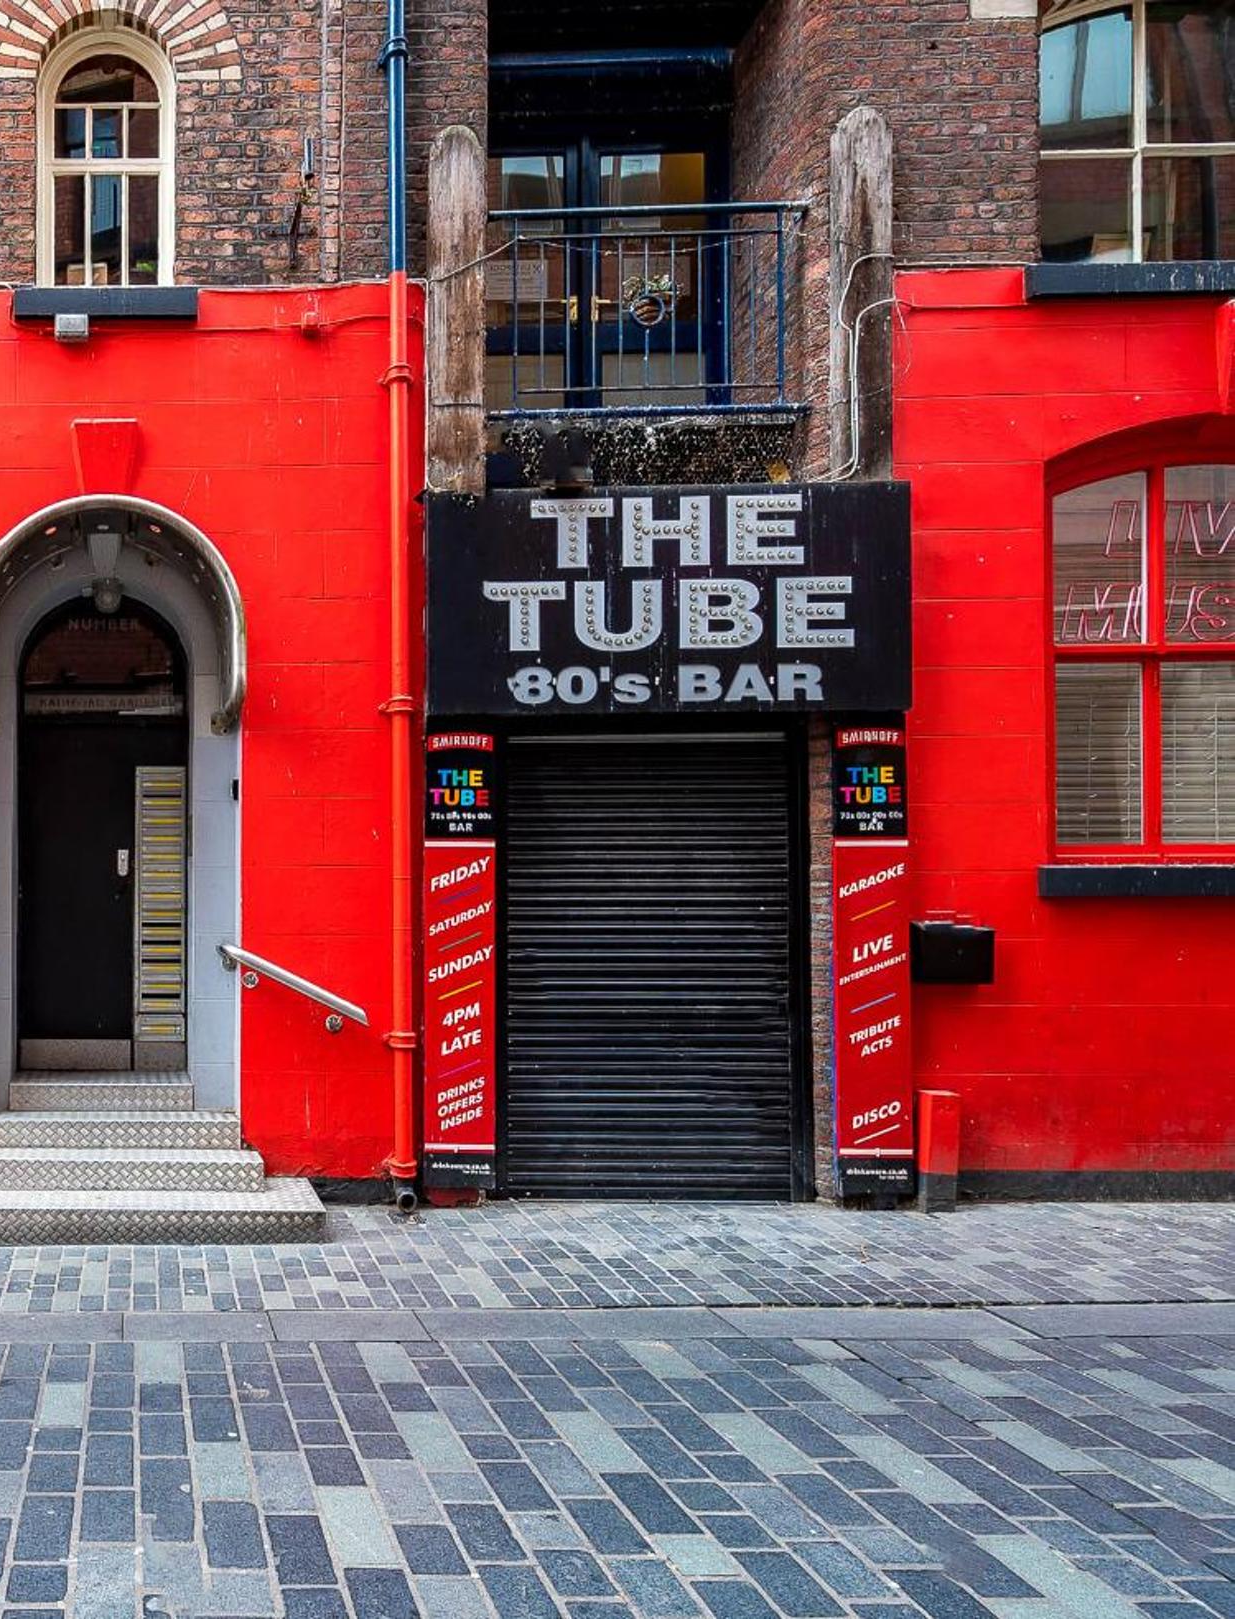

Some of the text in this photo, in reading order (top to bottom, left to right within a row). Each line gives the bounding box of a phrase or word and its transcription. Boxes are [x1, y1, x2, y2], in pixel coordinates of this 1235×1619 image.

[531, 493, 805, 569] THE
[68, 617, 140, 632] NUMBER
[483, 575, 855, 652] TUBE
[509, 663, 825, 704] 80's BAR
[432, 735, 489, 749] SMIRNOFF
[842, 730, 899, 744] SMIRNOFF
[437, 768, 484, 787] THE
[846, 766, 895, 784] THE
[429, 788, 490, 806] TUBE
[840, 786, 902, 804] TUBE
[449, 822, 473, 832] BAR
[859, 821, 884, 831] BAR
[430, 856, 491, 892] FRIDAY
[839, 863, 905, 898] KARAOKE
[429, 900, 493, 936] SATURDAY
[852, 933, 893, 963] LIVE
[428, 945, 493, 983] SUNDAY
[839, 953, 907, 986] ENTERTAINMENT
[442, 1001, 481, 1027] 4PM
[440, 1029, 482, 1057] LATE
[849, 1015, 902, 1045] TRIBUTE
[861, 1035, 893, 1058] ACTS
[437, 1076, 486, 1104] DRINKS
[438, 1091, 484, 1118] OFFERS
[852, 1101, 902, 1129] DISCO
[440, 1106, 484, 1131] INSIDE
